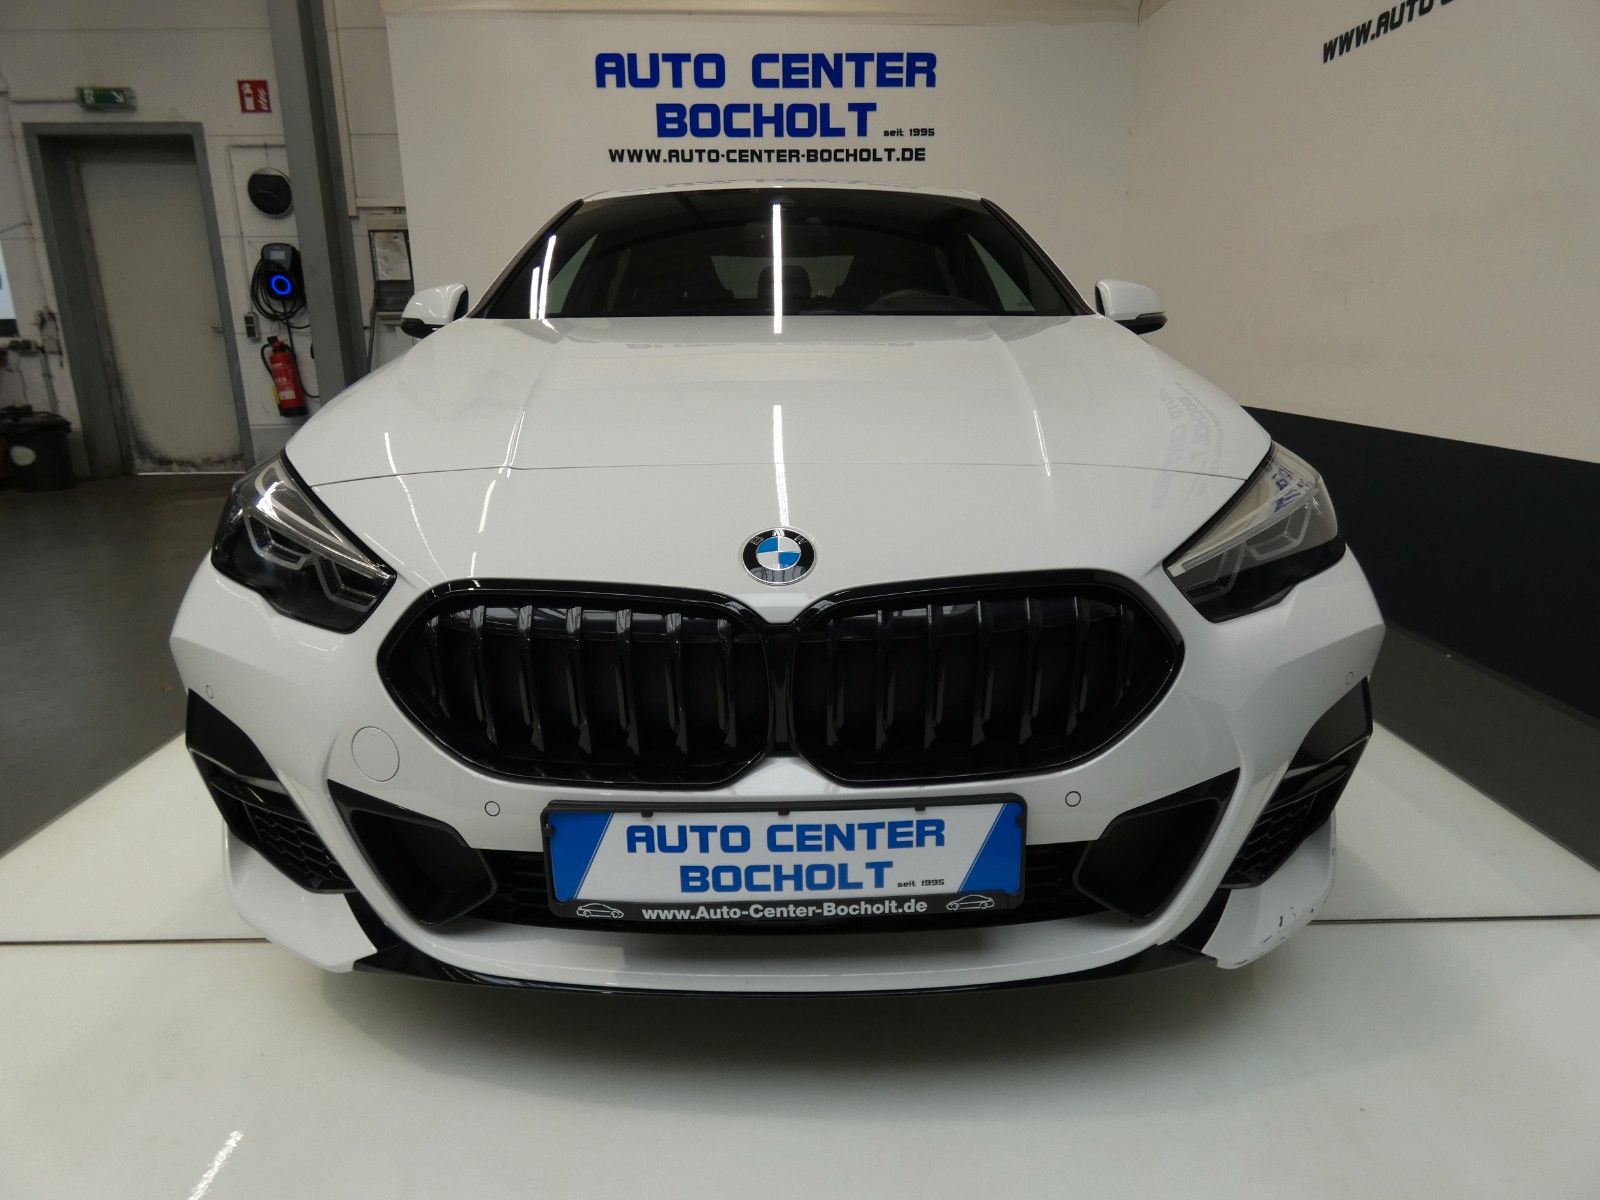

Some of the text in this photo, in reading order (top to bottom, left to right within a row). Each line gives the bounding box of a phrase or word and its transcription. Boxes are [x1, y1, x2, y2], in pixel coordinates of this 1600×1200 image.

[1323, 0, 1453, 63] WWW.AUTO
[595, 52, 937, 88] AUTO CENTER
[656, 102, 935, 138] BOCHOLT seit 1995
[608, 147, 926, 164] WWW.AUTO-CENTER-BOCHOLT.DE
[626, 818, 945, 854] AUTO CENTER
[680, 861, 945, 893] BOCHOLT seit 1995
[641, 898, 928, 921] www.Auto-Center-Bocholt.de
